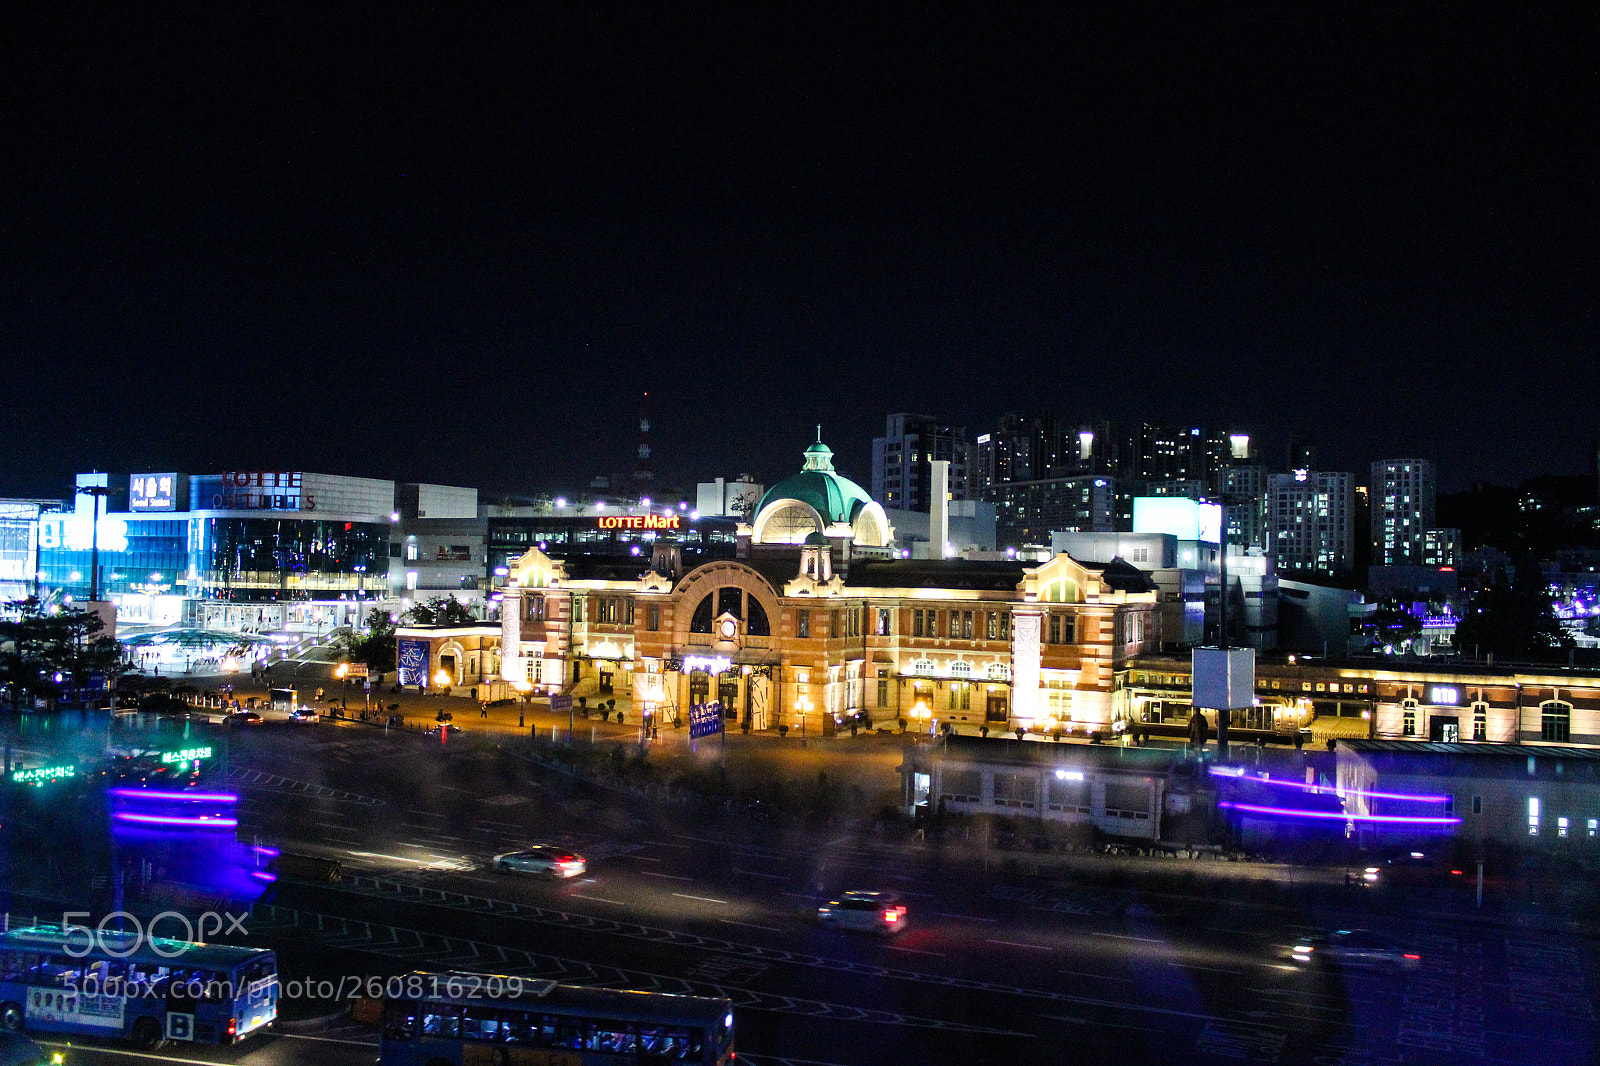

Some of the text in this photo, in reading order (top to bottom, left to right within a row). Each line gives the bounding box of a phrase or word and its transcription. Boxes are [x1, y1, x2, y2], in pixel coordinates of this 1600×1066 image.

[132, 476, 172, 498] 서울역
[132, 498, 171, 507] Seoul Station
[598, 514, 680, 529] LOTTE Mart
